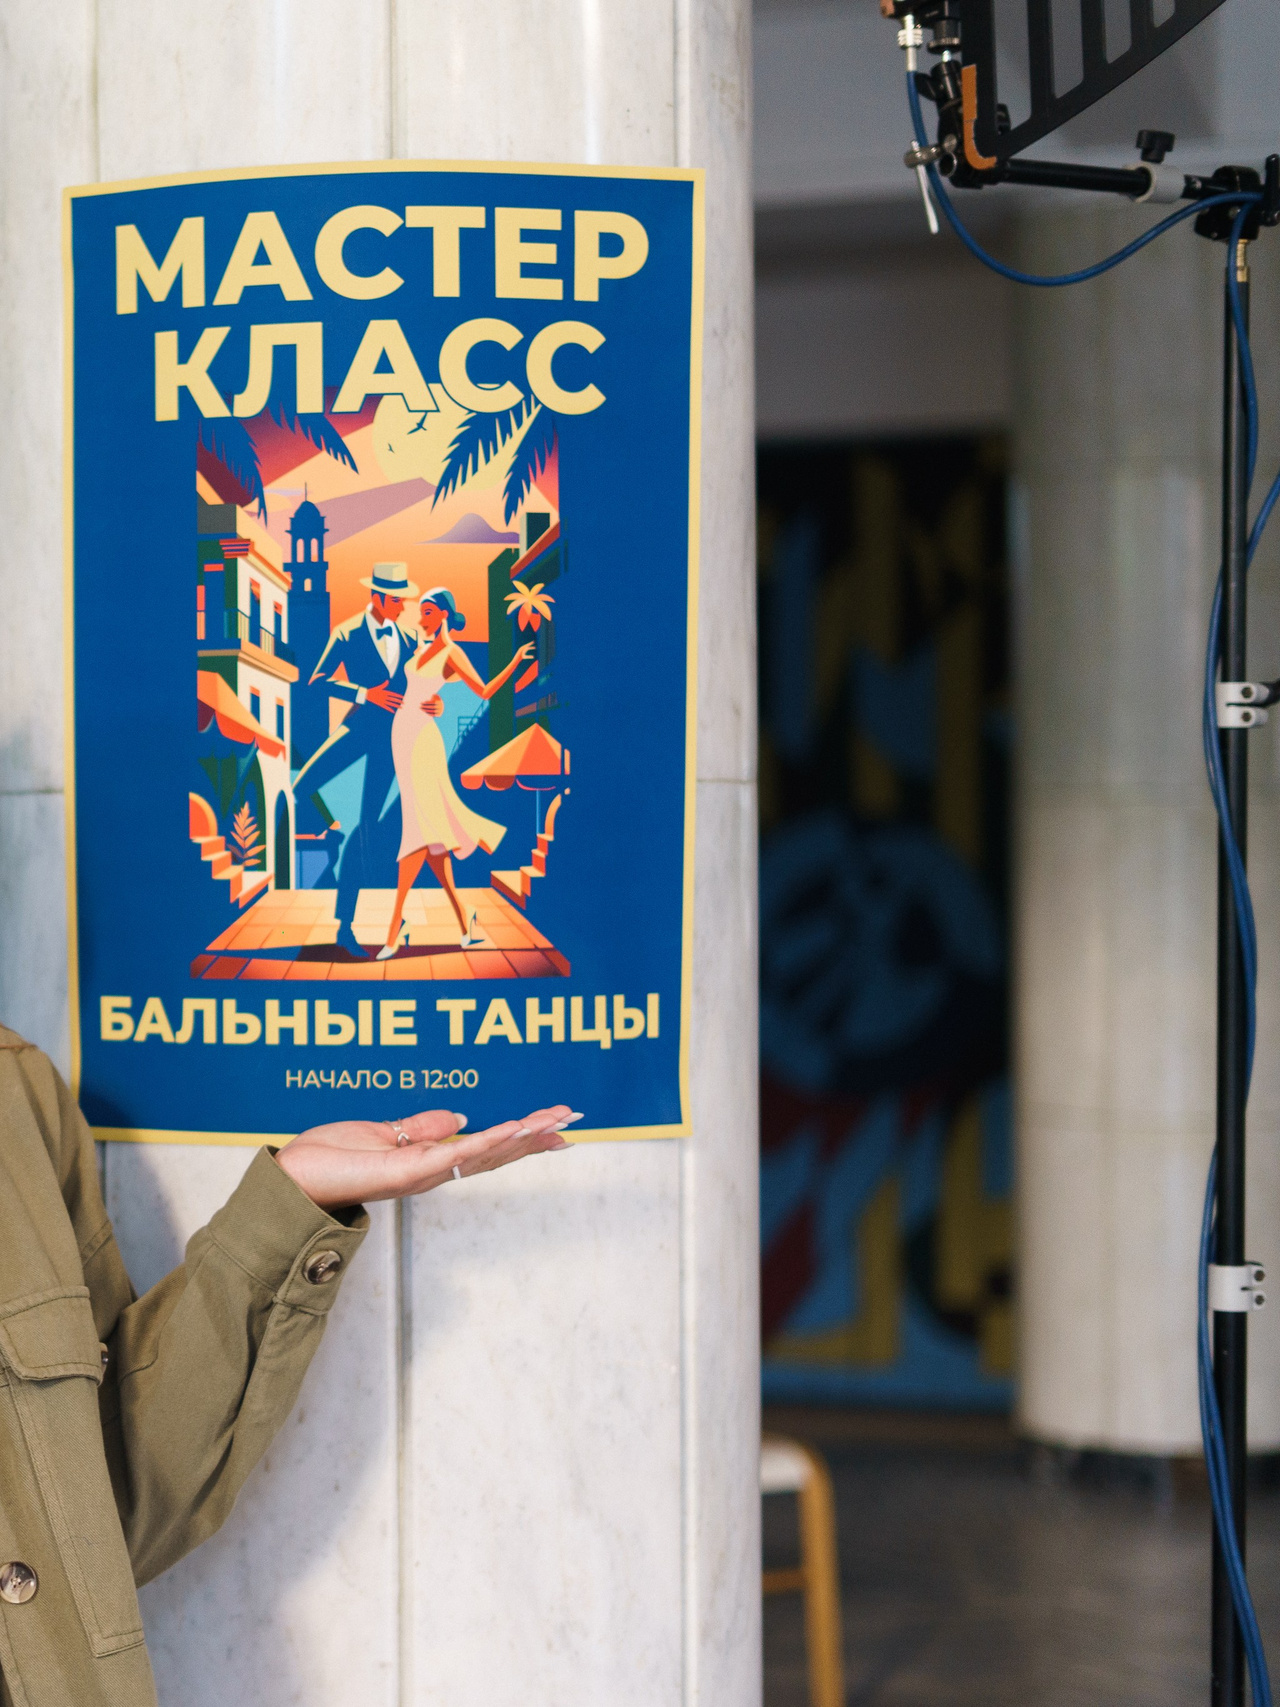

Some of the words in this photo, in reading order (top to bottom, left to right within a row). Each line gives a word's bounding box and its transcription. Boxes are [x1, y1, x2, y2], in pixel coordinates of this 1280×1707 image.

[115, 204, 649, 315] МАСТЕР
[155, 318, 607, 422] КЛАСС
[100, 995, 418, 1046] БАЛЬНЫЕ
[435, 992, 660, 1050] ТАНЦЫ
[285, 1069, 393, 1090] НАЧАЛО
[399, 1069, 417, 1089] В
[420, 1068, 480, 1090] 12:00
